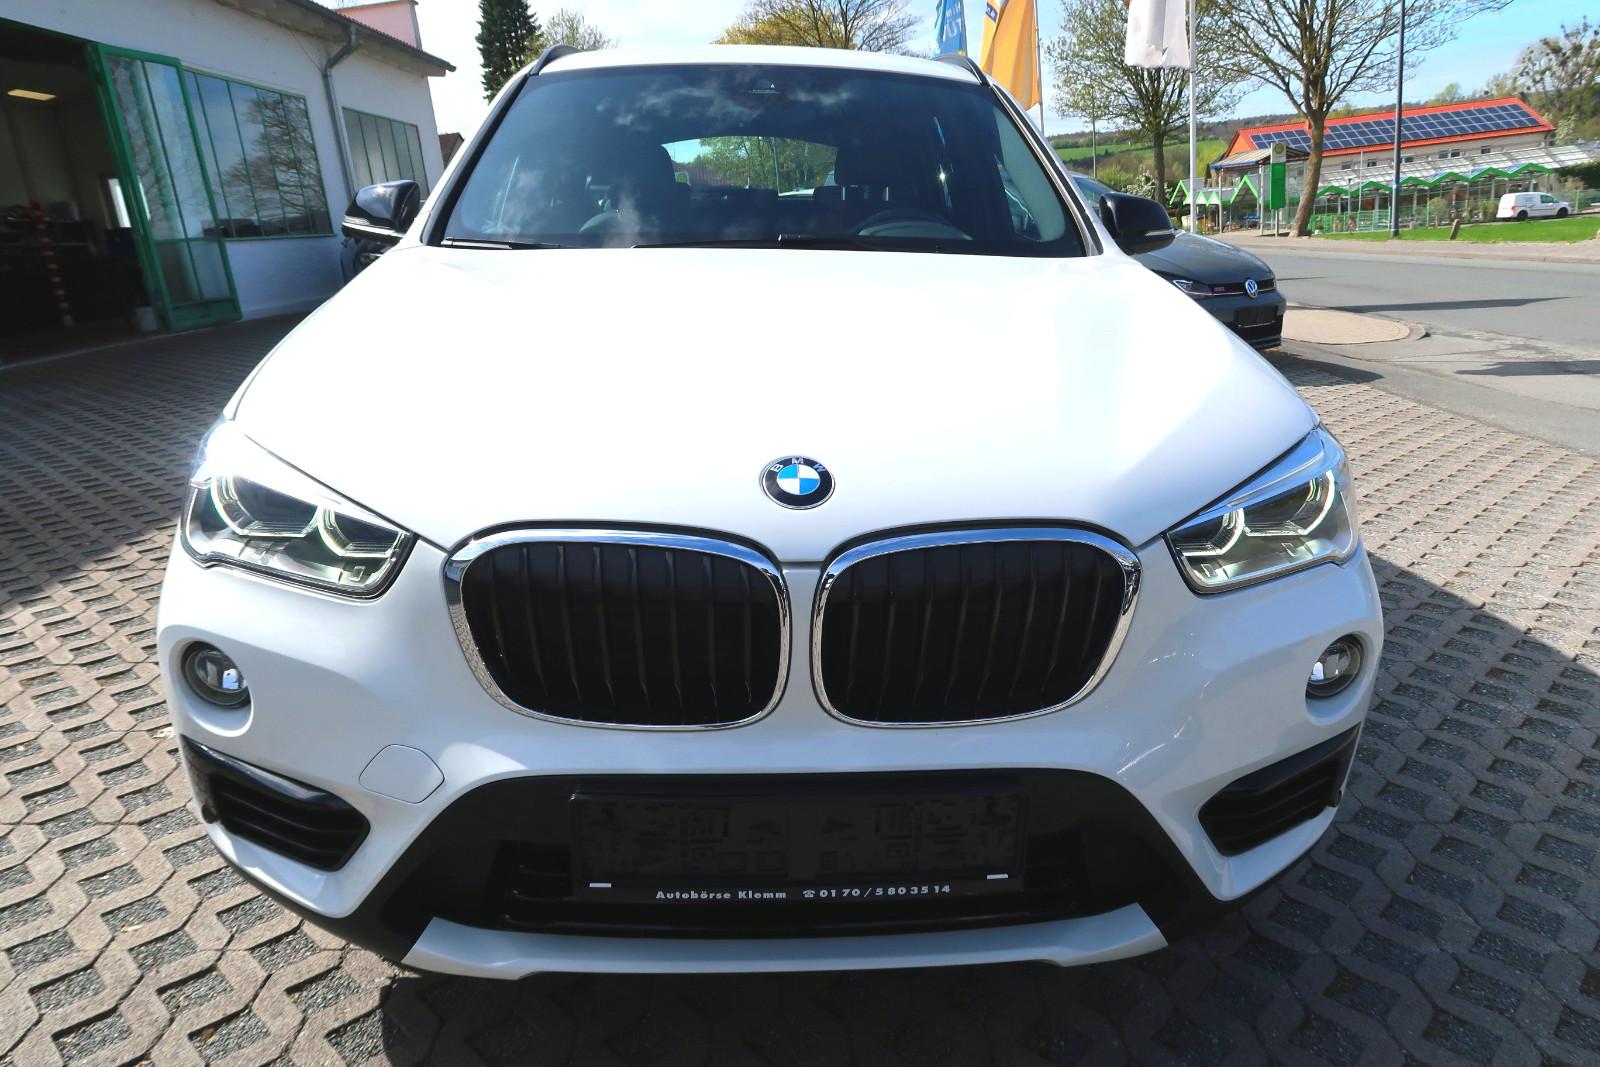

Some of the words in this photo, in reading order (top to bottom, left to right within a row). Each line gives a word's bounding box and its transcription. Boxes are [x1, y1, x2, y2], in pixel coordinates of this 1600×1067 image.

[768, 457, 827, 472] BMW
[655, 890, 732, 899] Autobörse
[738, 890, 787, 899] Klemm
